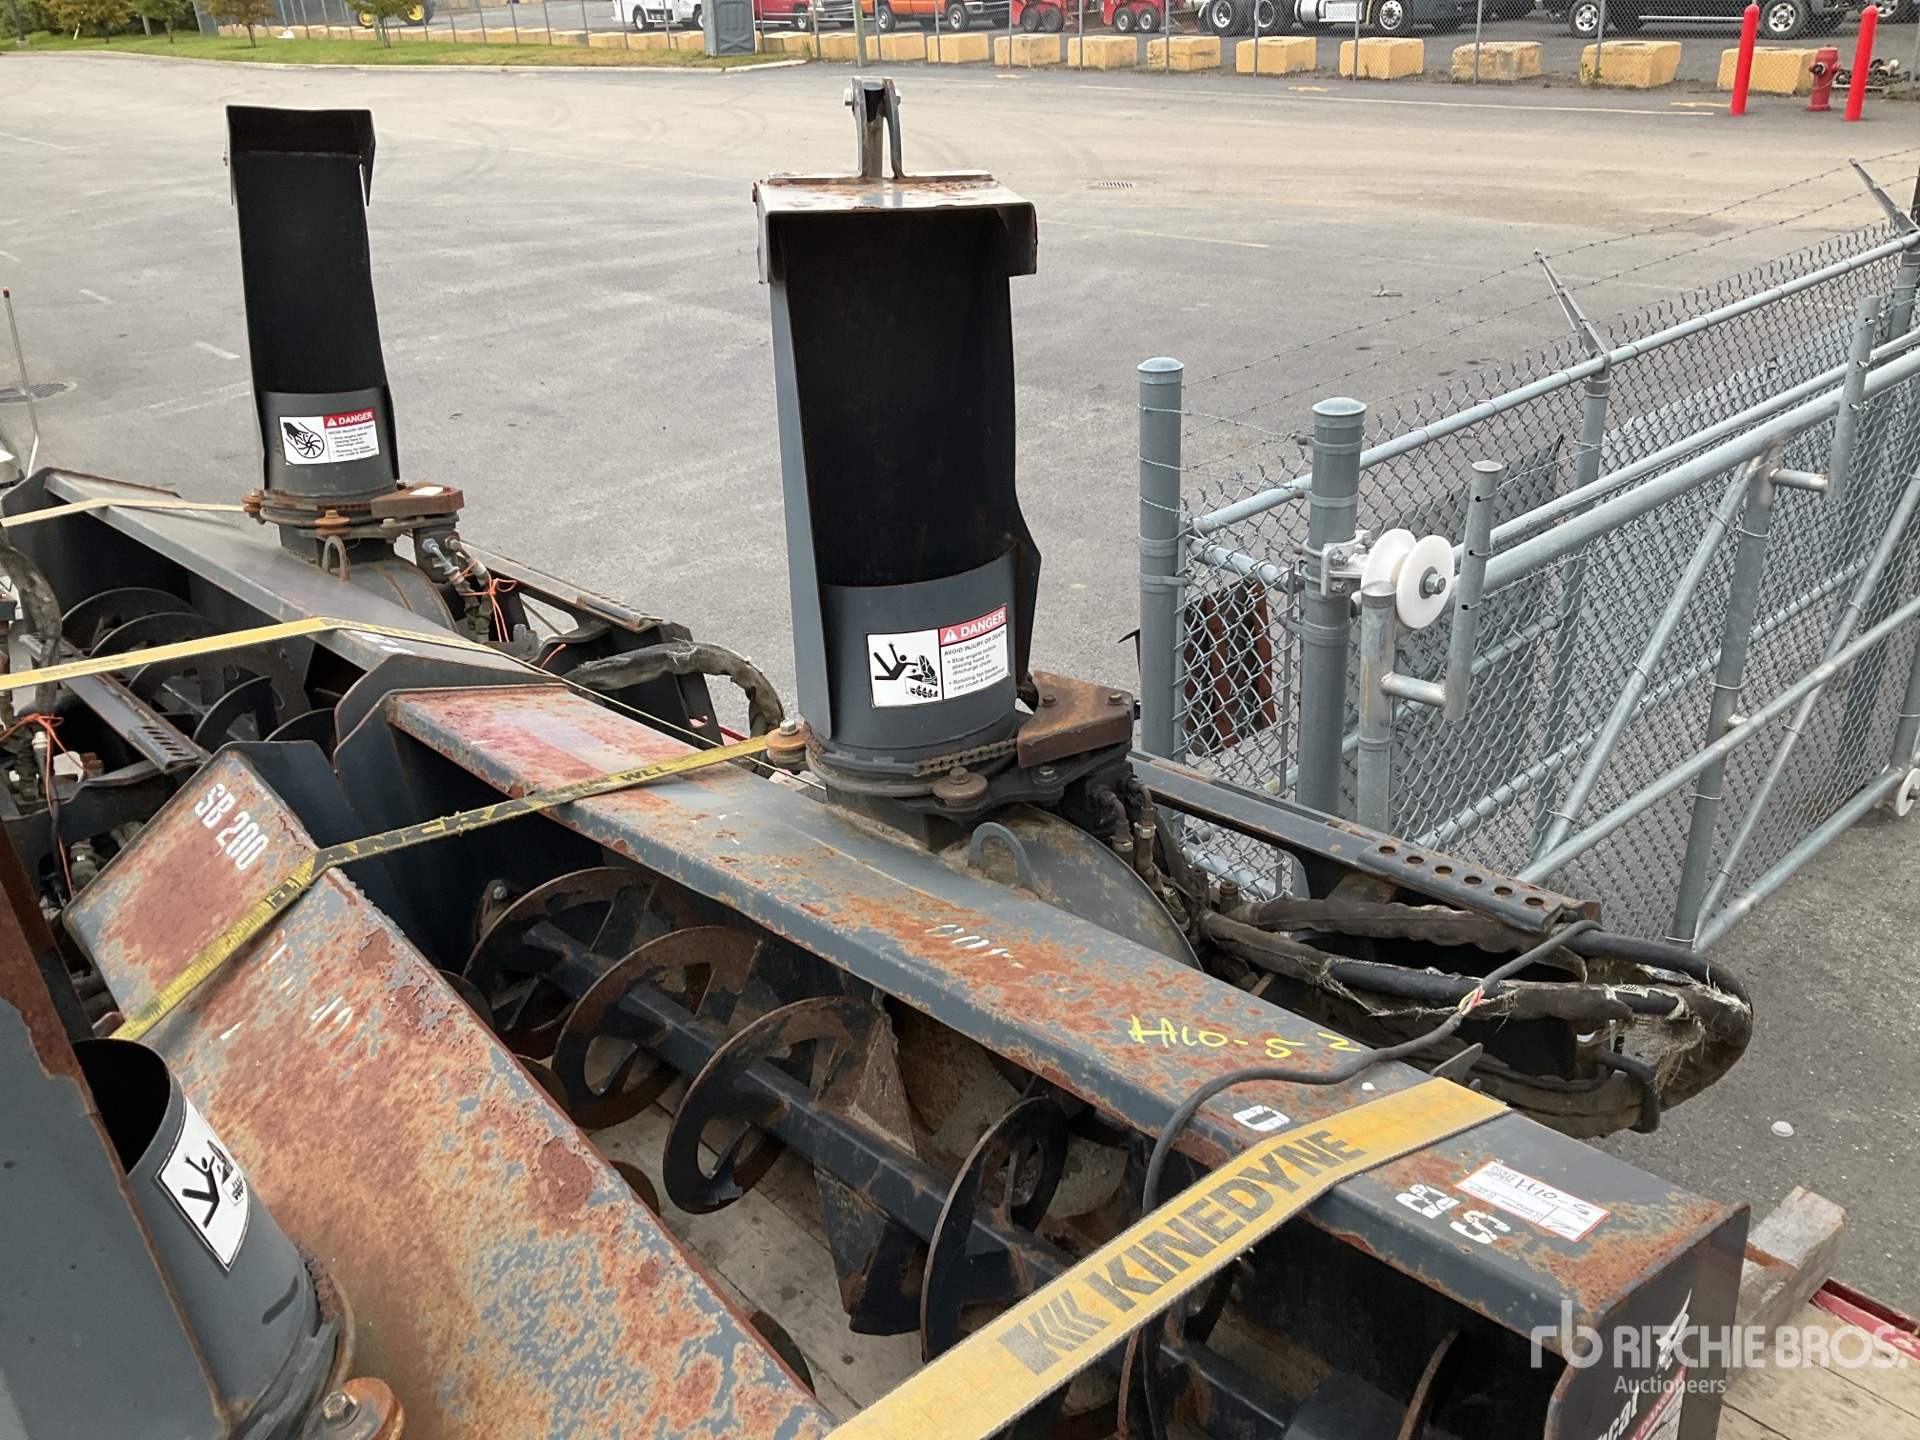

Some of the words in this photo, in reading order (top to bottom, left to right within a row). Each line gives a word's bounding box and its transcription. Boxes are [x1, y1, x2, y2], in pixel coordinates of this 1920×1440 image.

[338, 412, 372, 425] DANGER
[960, 610, 1005, 638] DANGER
[944, 647, 963, 656] AVOID
[964, 641, 983, 651] INJURY
[985, 636, 992, 644] OR
[619, 765, 670, 781] WLL
[195, 783, 235, 829] SB
[216, 811, 269, 870] 200
[1082, 1129, 1367, 1314] KINEDYNE
